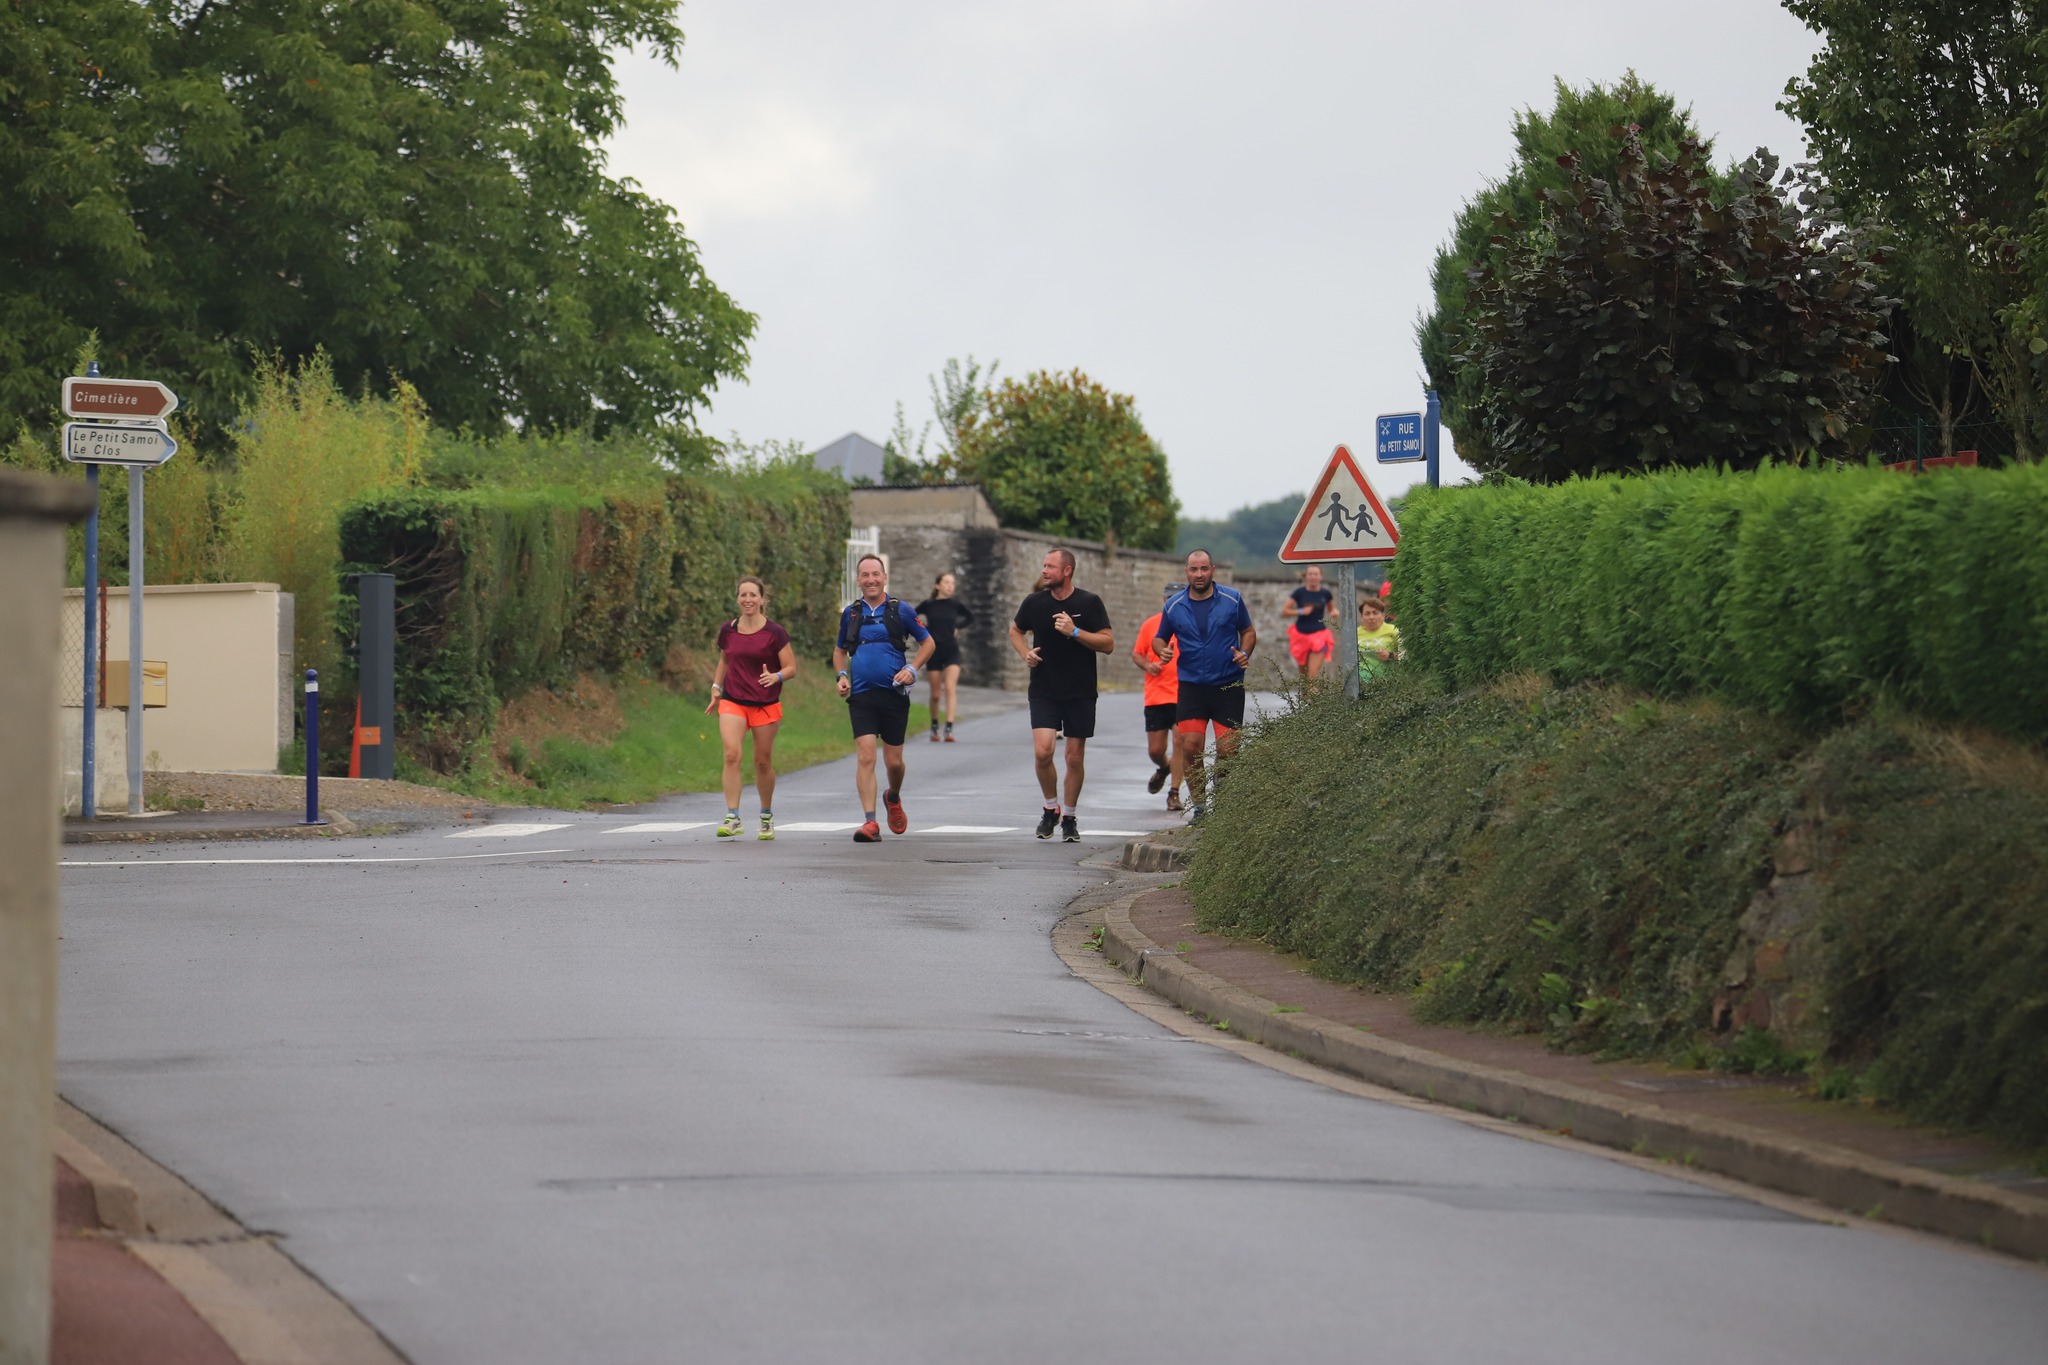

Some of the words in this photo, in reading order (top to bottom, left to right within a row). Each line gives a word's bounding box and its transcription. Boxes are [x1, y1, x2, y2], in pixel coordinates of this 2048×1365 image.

[75, 391, 138, 404] Cimetière
[1399, 422, 1414, 434] RUE
[74, 430, 86, 441] Le
[89, 431, 119, 443] Petit
[121, 433, 159, 445] Samoi
[74, 443, 86, 454] Le
[94, 444, 121, 456] Clos
[1380, 442, 1386, 453] du
[1388, 440, 1402, 452] PETIT
[1403, 439, 1419, 451] SAMOI
